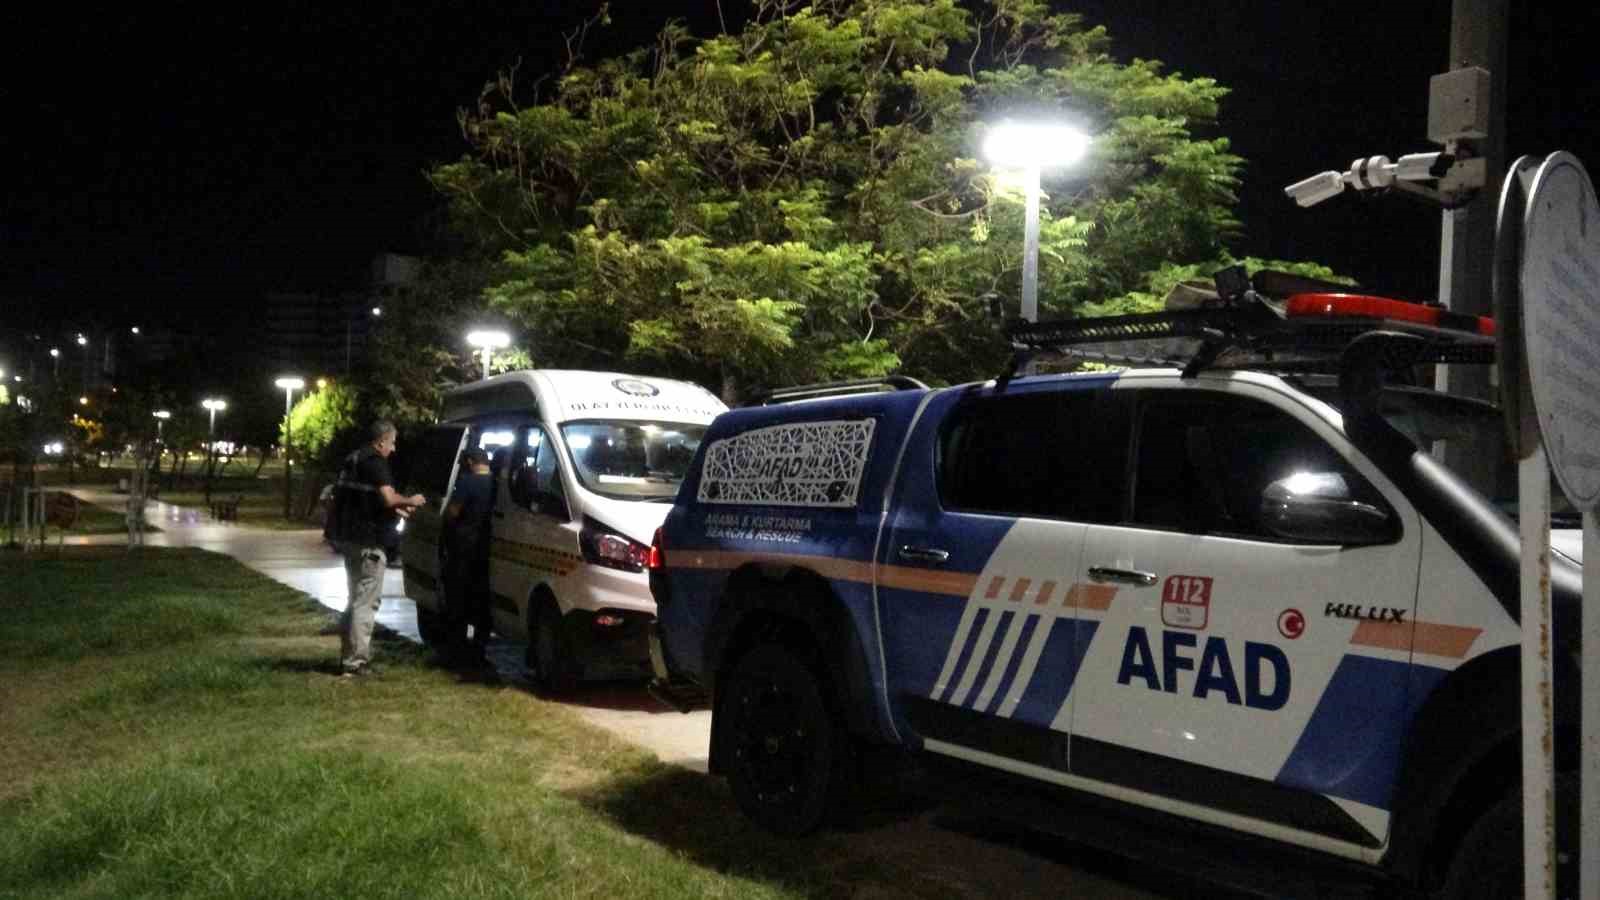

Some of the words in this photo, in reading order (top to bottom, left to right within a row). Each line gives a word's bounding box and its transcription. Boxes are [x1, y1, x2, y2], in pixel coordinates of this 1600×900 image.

[759, 457, 803, 478] AFAD
[752, 515, 811, 530] KURTARMA
[755, 531, 801, 543] RESCUE
[1170, 577, 1204, 603] 112
[1324, 602, 1407, 624] HILUX
[1116, 626, 1292, 711] AFAD
